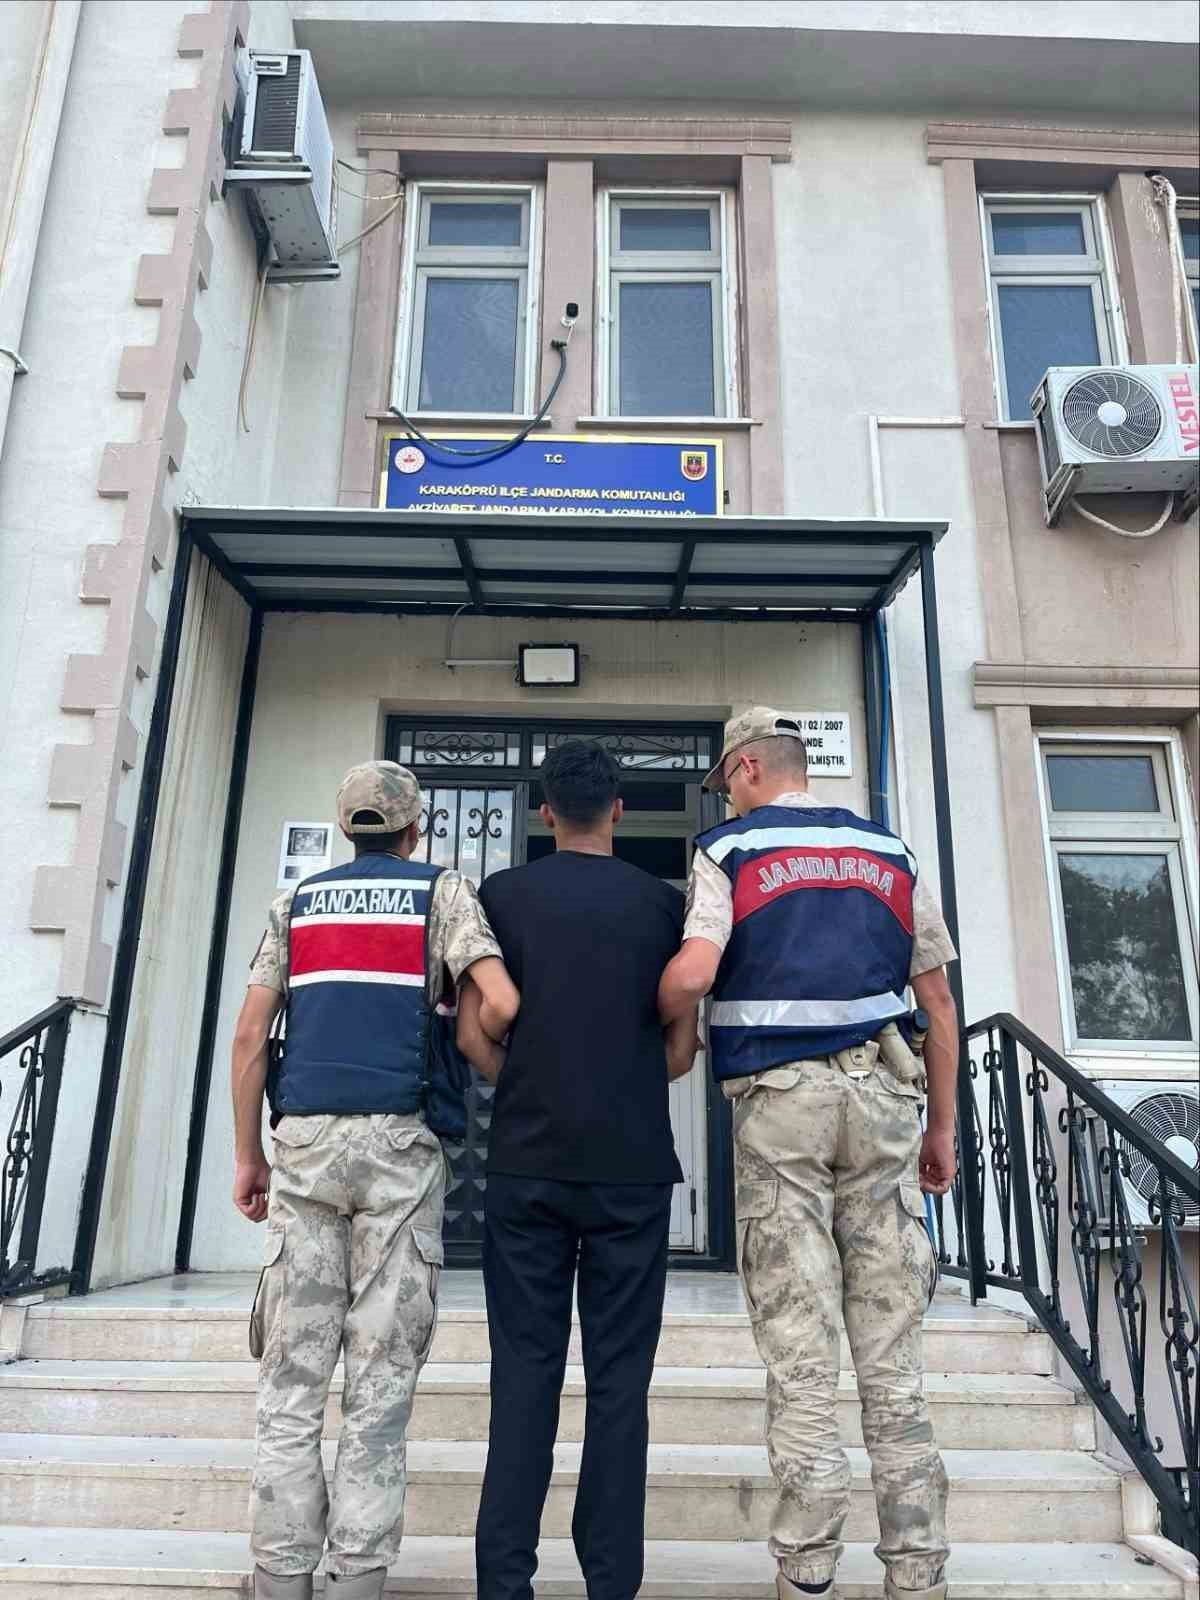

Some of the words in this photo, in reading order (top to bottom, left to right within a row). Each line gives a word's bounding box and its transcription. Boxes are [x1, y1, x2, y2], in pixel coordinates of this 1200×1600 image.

[1168, 372, 1199, 452] VESTEL
[544, 454, 566, 463] T.C.
[530, 487, 599, 499] JANDARMA
[601, 489, 685, 502] KOMUTANLIĞI
[825, 721, 843, 731] 2007
[807, 755, 845, 767] ILMIŞTIR
[757, 856, 893, 897] JANDARMA
[304, 889, 416, 915] JANDARMA
